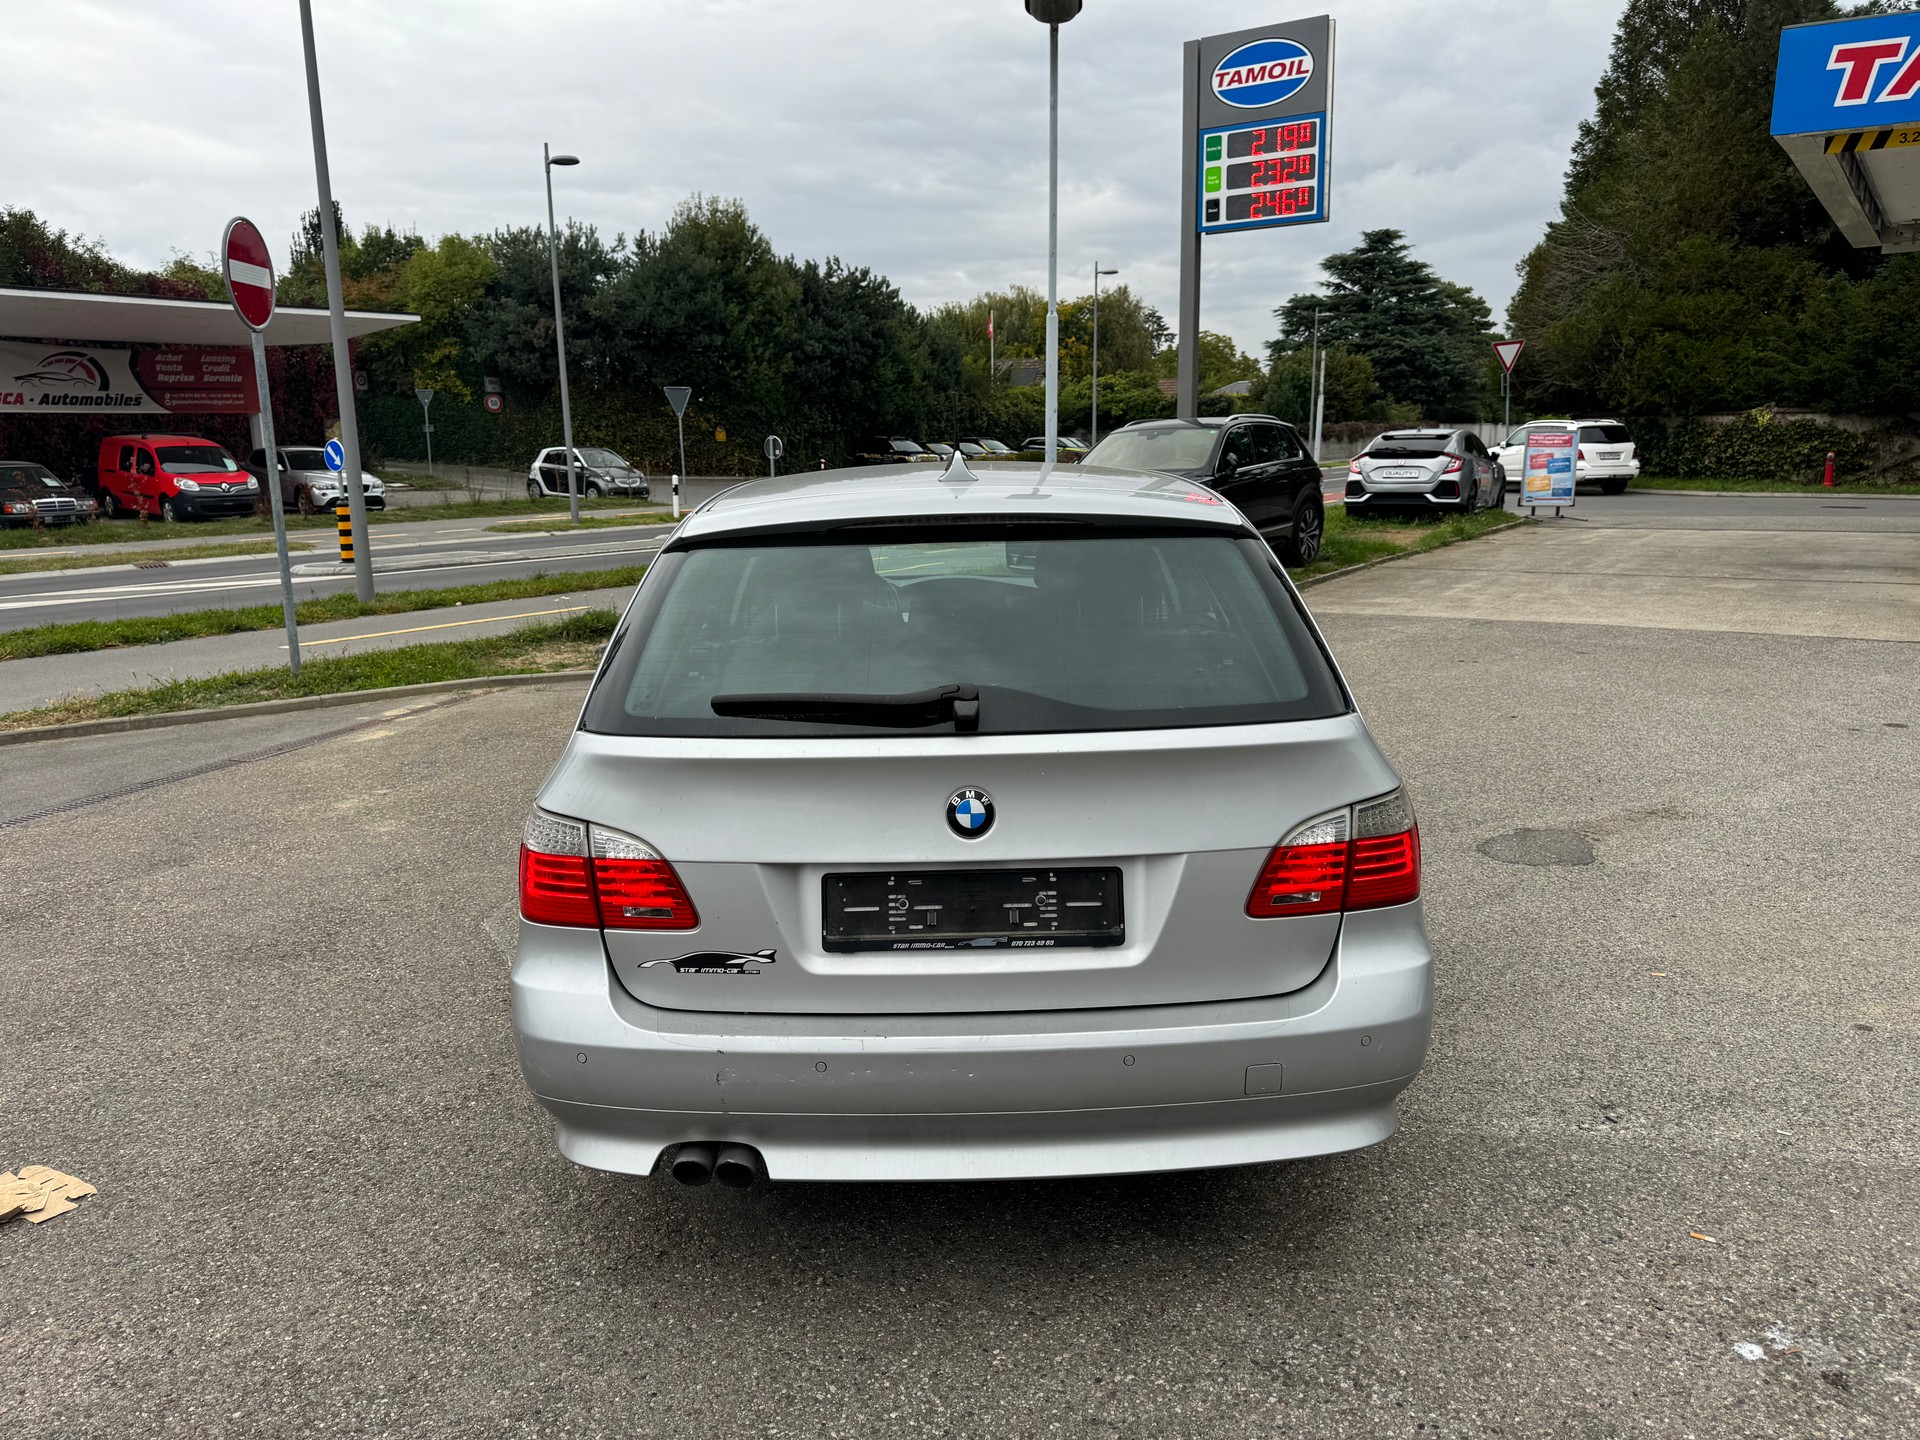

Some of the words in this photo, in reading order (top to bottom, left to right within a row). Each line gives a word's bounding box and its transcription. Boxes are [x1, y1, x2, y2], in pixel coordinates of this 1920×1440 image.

[1215, 59, 1310, 89] TAMOIL
[1251, 155, 1310, 188] 2320
[1250, 187, 1309, 219] 2460
[154, 353, 183, 362] Achat
[200, 354, 236, 364] Leasing
[155, 363, 183, 372] Vente
[157, 373, 195, 383] Reprise
[203, 374, 243, 382] Garantie
[0, 392, 24, 405] CA
[38, 393, 143, 406] Automobiles
[951, 790, 991, 806] BMW
